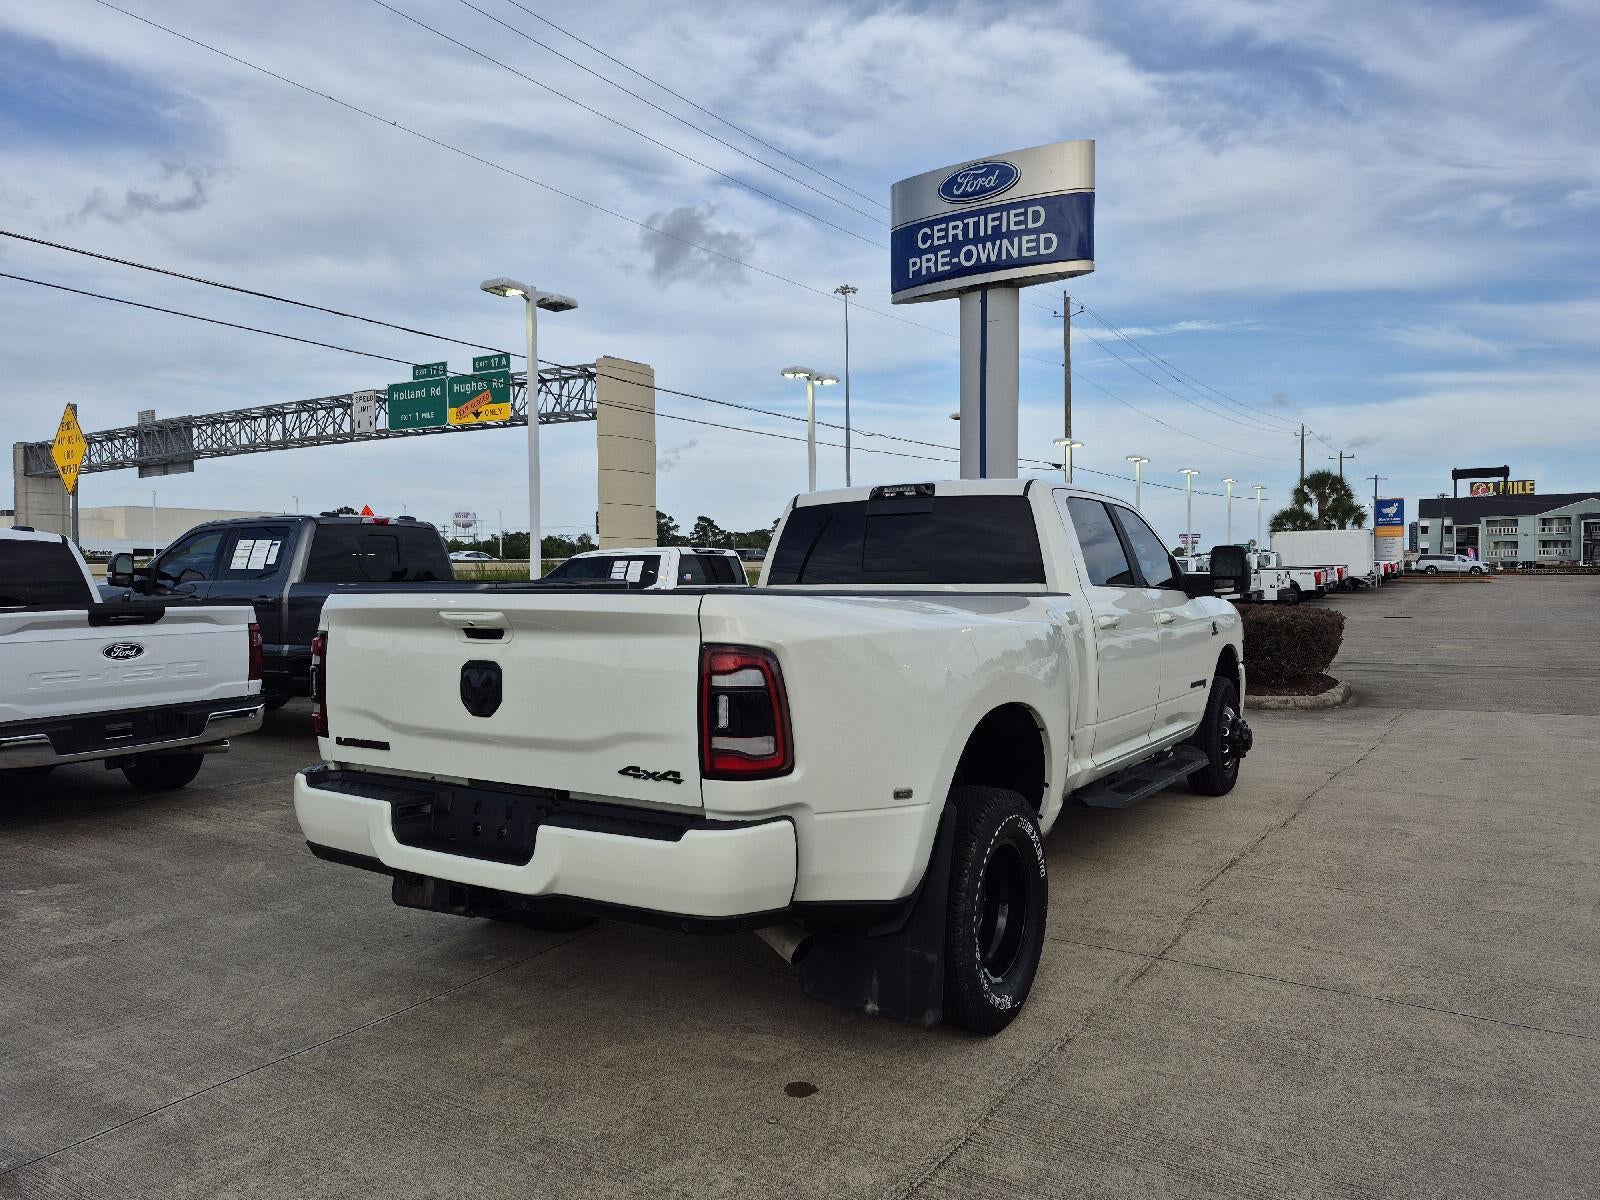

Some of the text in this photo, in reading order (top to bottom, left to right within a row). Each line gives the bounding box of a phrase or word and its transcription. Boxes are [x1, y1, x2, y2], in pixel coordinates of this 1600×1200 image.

[953, 167, 1000, 195] Ford
[917, 205, 1046, 250] CERTIFIED
[908, 232, 1059, 279] PRE-OWNED
[475, 360, 488, 369] EXIT
[415, 368, 427, 376] EXIT
[453, 377, 504, 394] Hughes Rd
[393, 385, 441, 401] Holland Rd
[415, 412, 420, 421] 1
[484, 407, 503, 417] ONLY
[1499, 480, 1535, 495] MILE
[87, 548, 113, 556] Service
[111, 644, 137, 657] Ford
